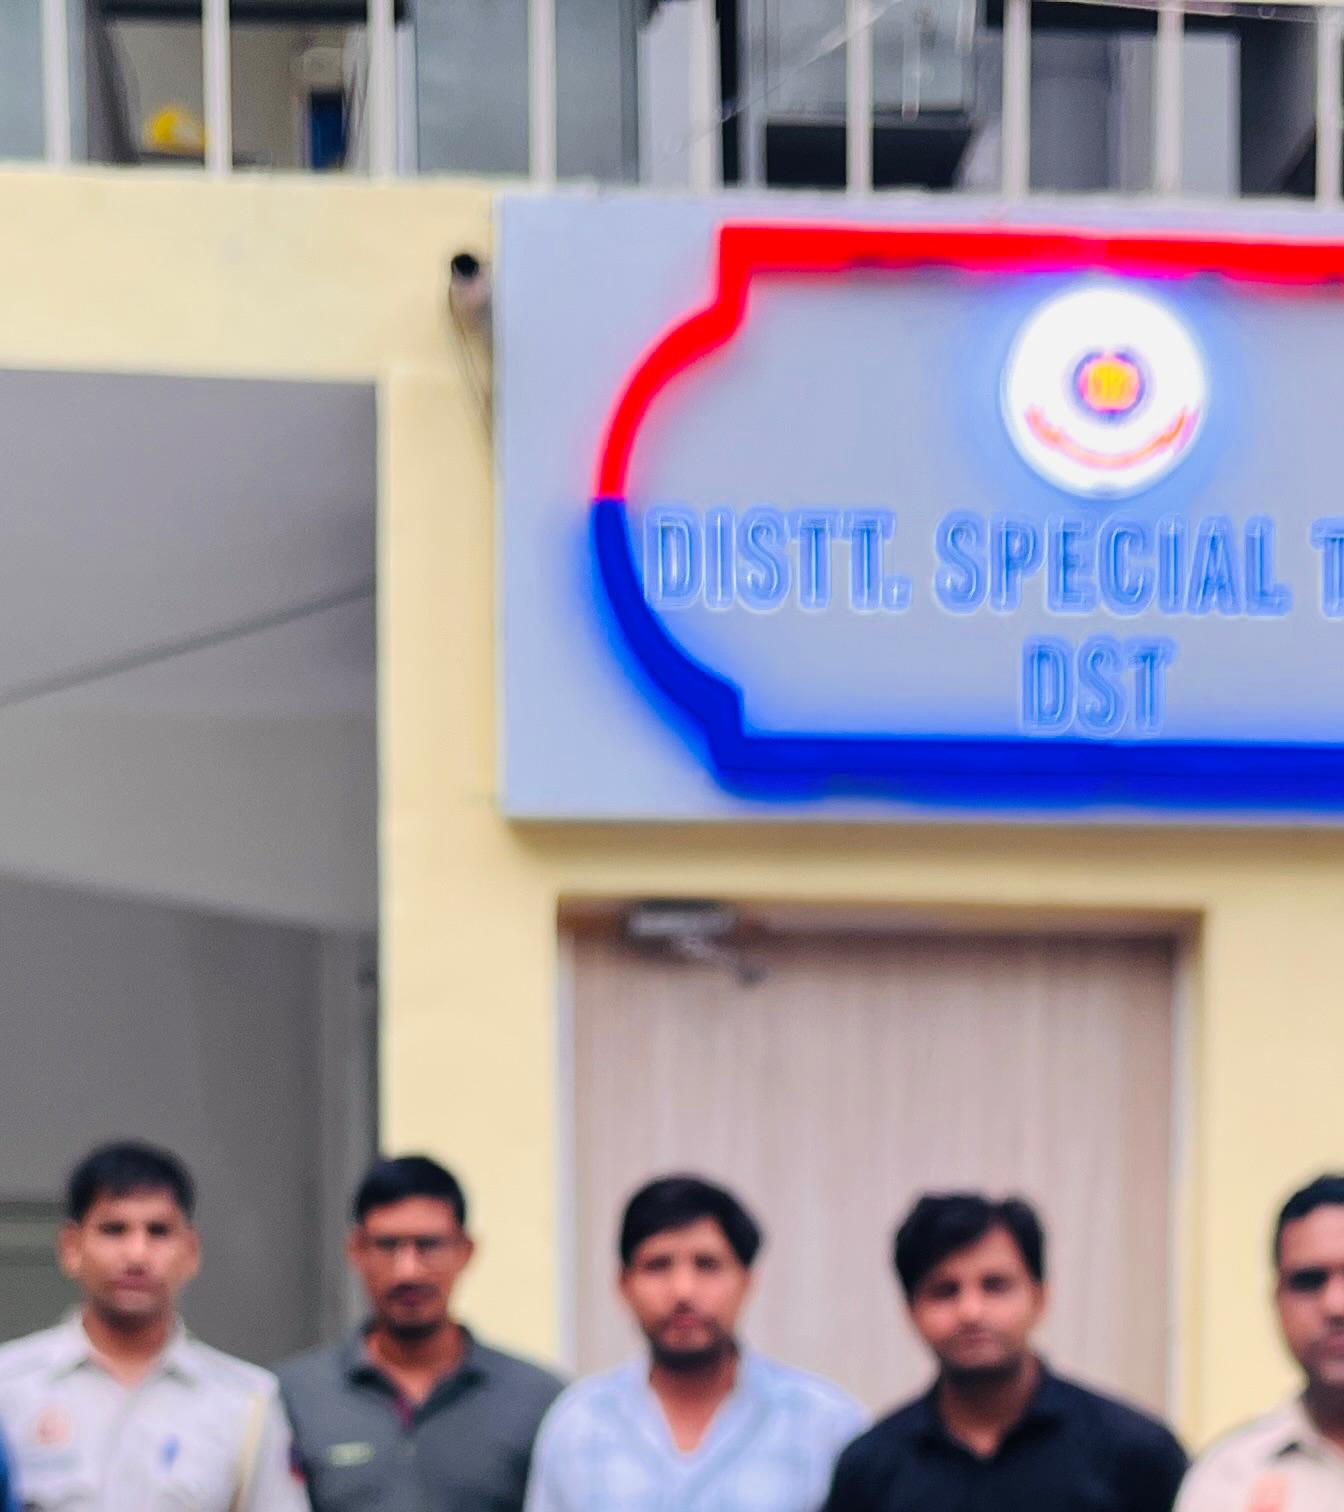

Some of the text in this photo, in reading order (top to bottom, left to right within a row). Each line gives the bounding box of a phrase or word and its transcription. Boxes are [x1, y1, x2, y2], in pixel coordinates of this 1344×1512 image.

[645, 507, 912, 613] DISTT.
[934, 510, 1291, 617] SPECIAL
[1022, 634, 1178, 737] DST
